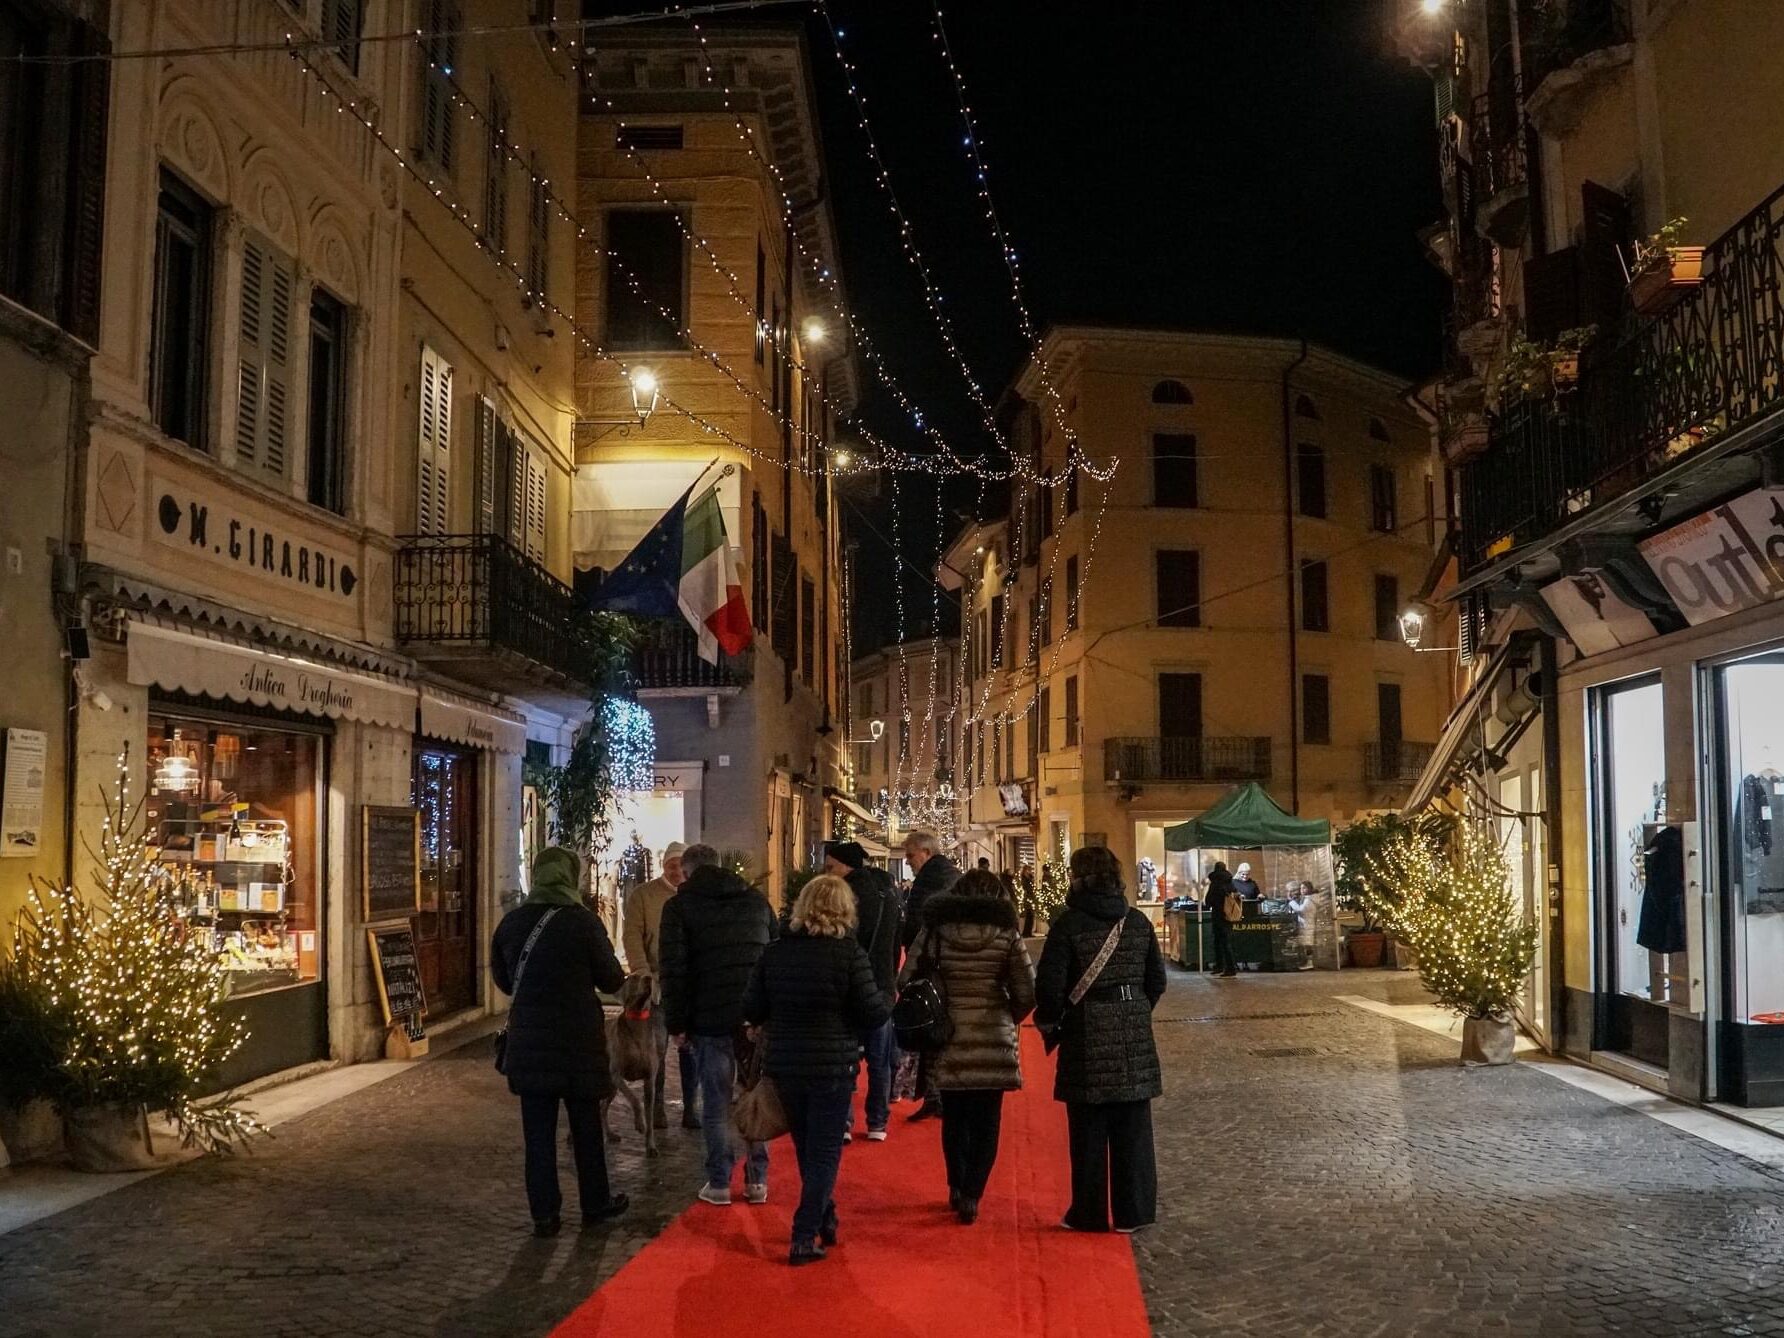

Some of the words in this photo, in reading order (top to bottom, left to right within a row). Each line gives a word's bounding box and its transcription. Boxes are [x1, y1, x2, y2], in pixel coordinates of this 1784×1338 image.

[240, 663, 285, 697] Antica
[298, 674, 353, 711] Drogheria
[1232, 922, 1281, 931] ALDARROSTE
